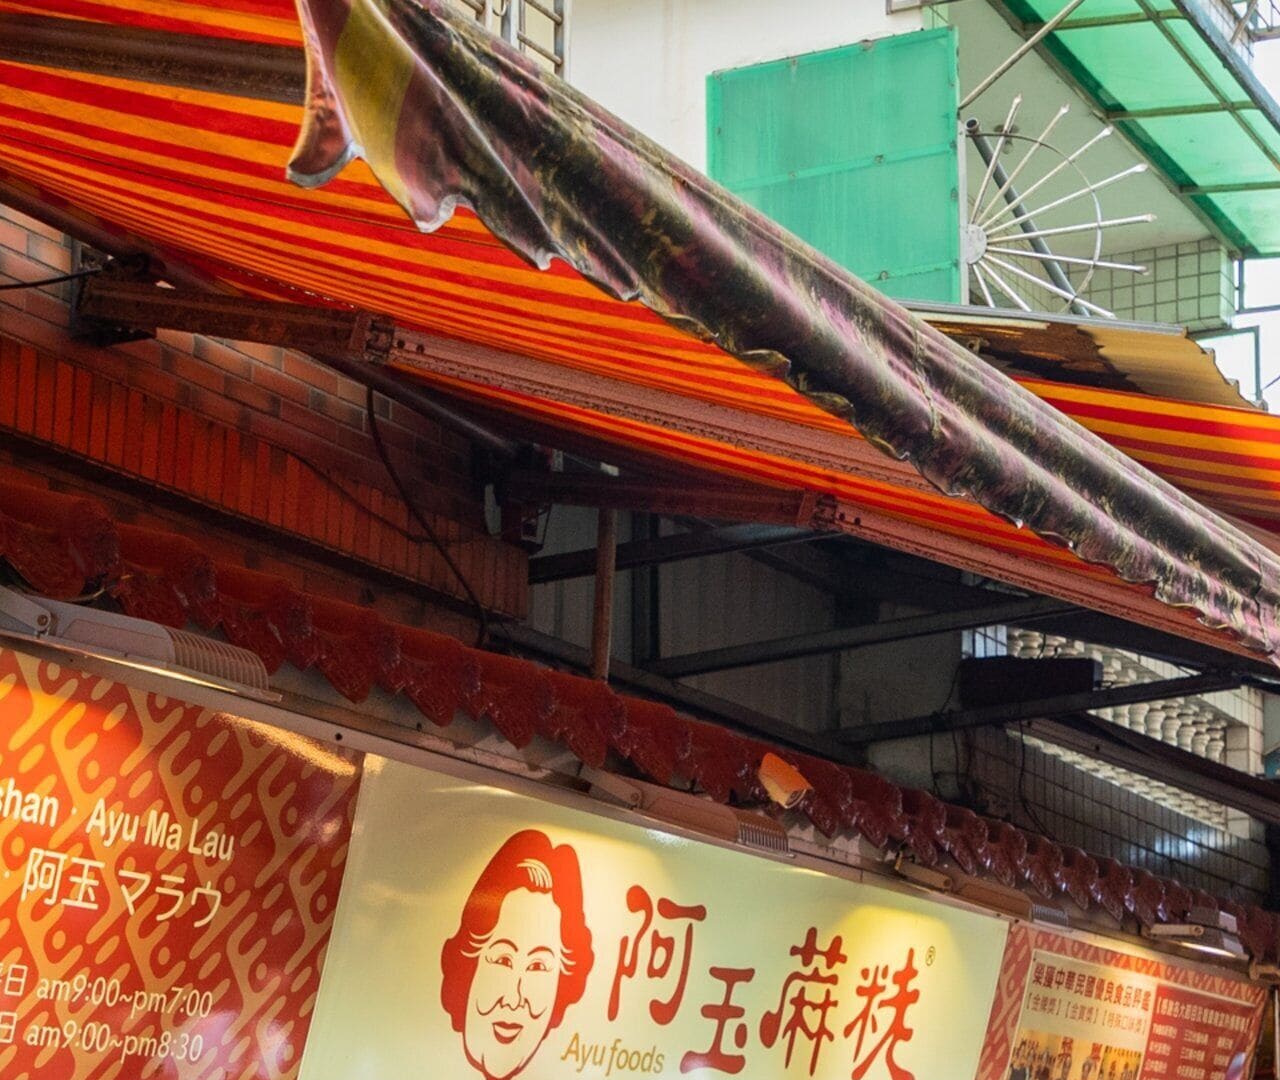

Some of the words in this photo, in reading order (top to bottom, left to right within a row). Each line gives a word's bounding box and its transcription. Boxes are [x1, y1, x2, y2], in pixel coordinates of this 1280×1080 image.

[86, 798, 139, 848] Ayu
[144, 809, 182, 851] Ma
[188, 818, 235, 862] Lau
[37, 974, 212, 1019] am9:00~pm7:00
[26, 1020, 202, 1064] am9:00~pm8:30
[561, 1032, 608, 1072] Ayu
[605, 1039, 665, 1077] foods
